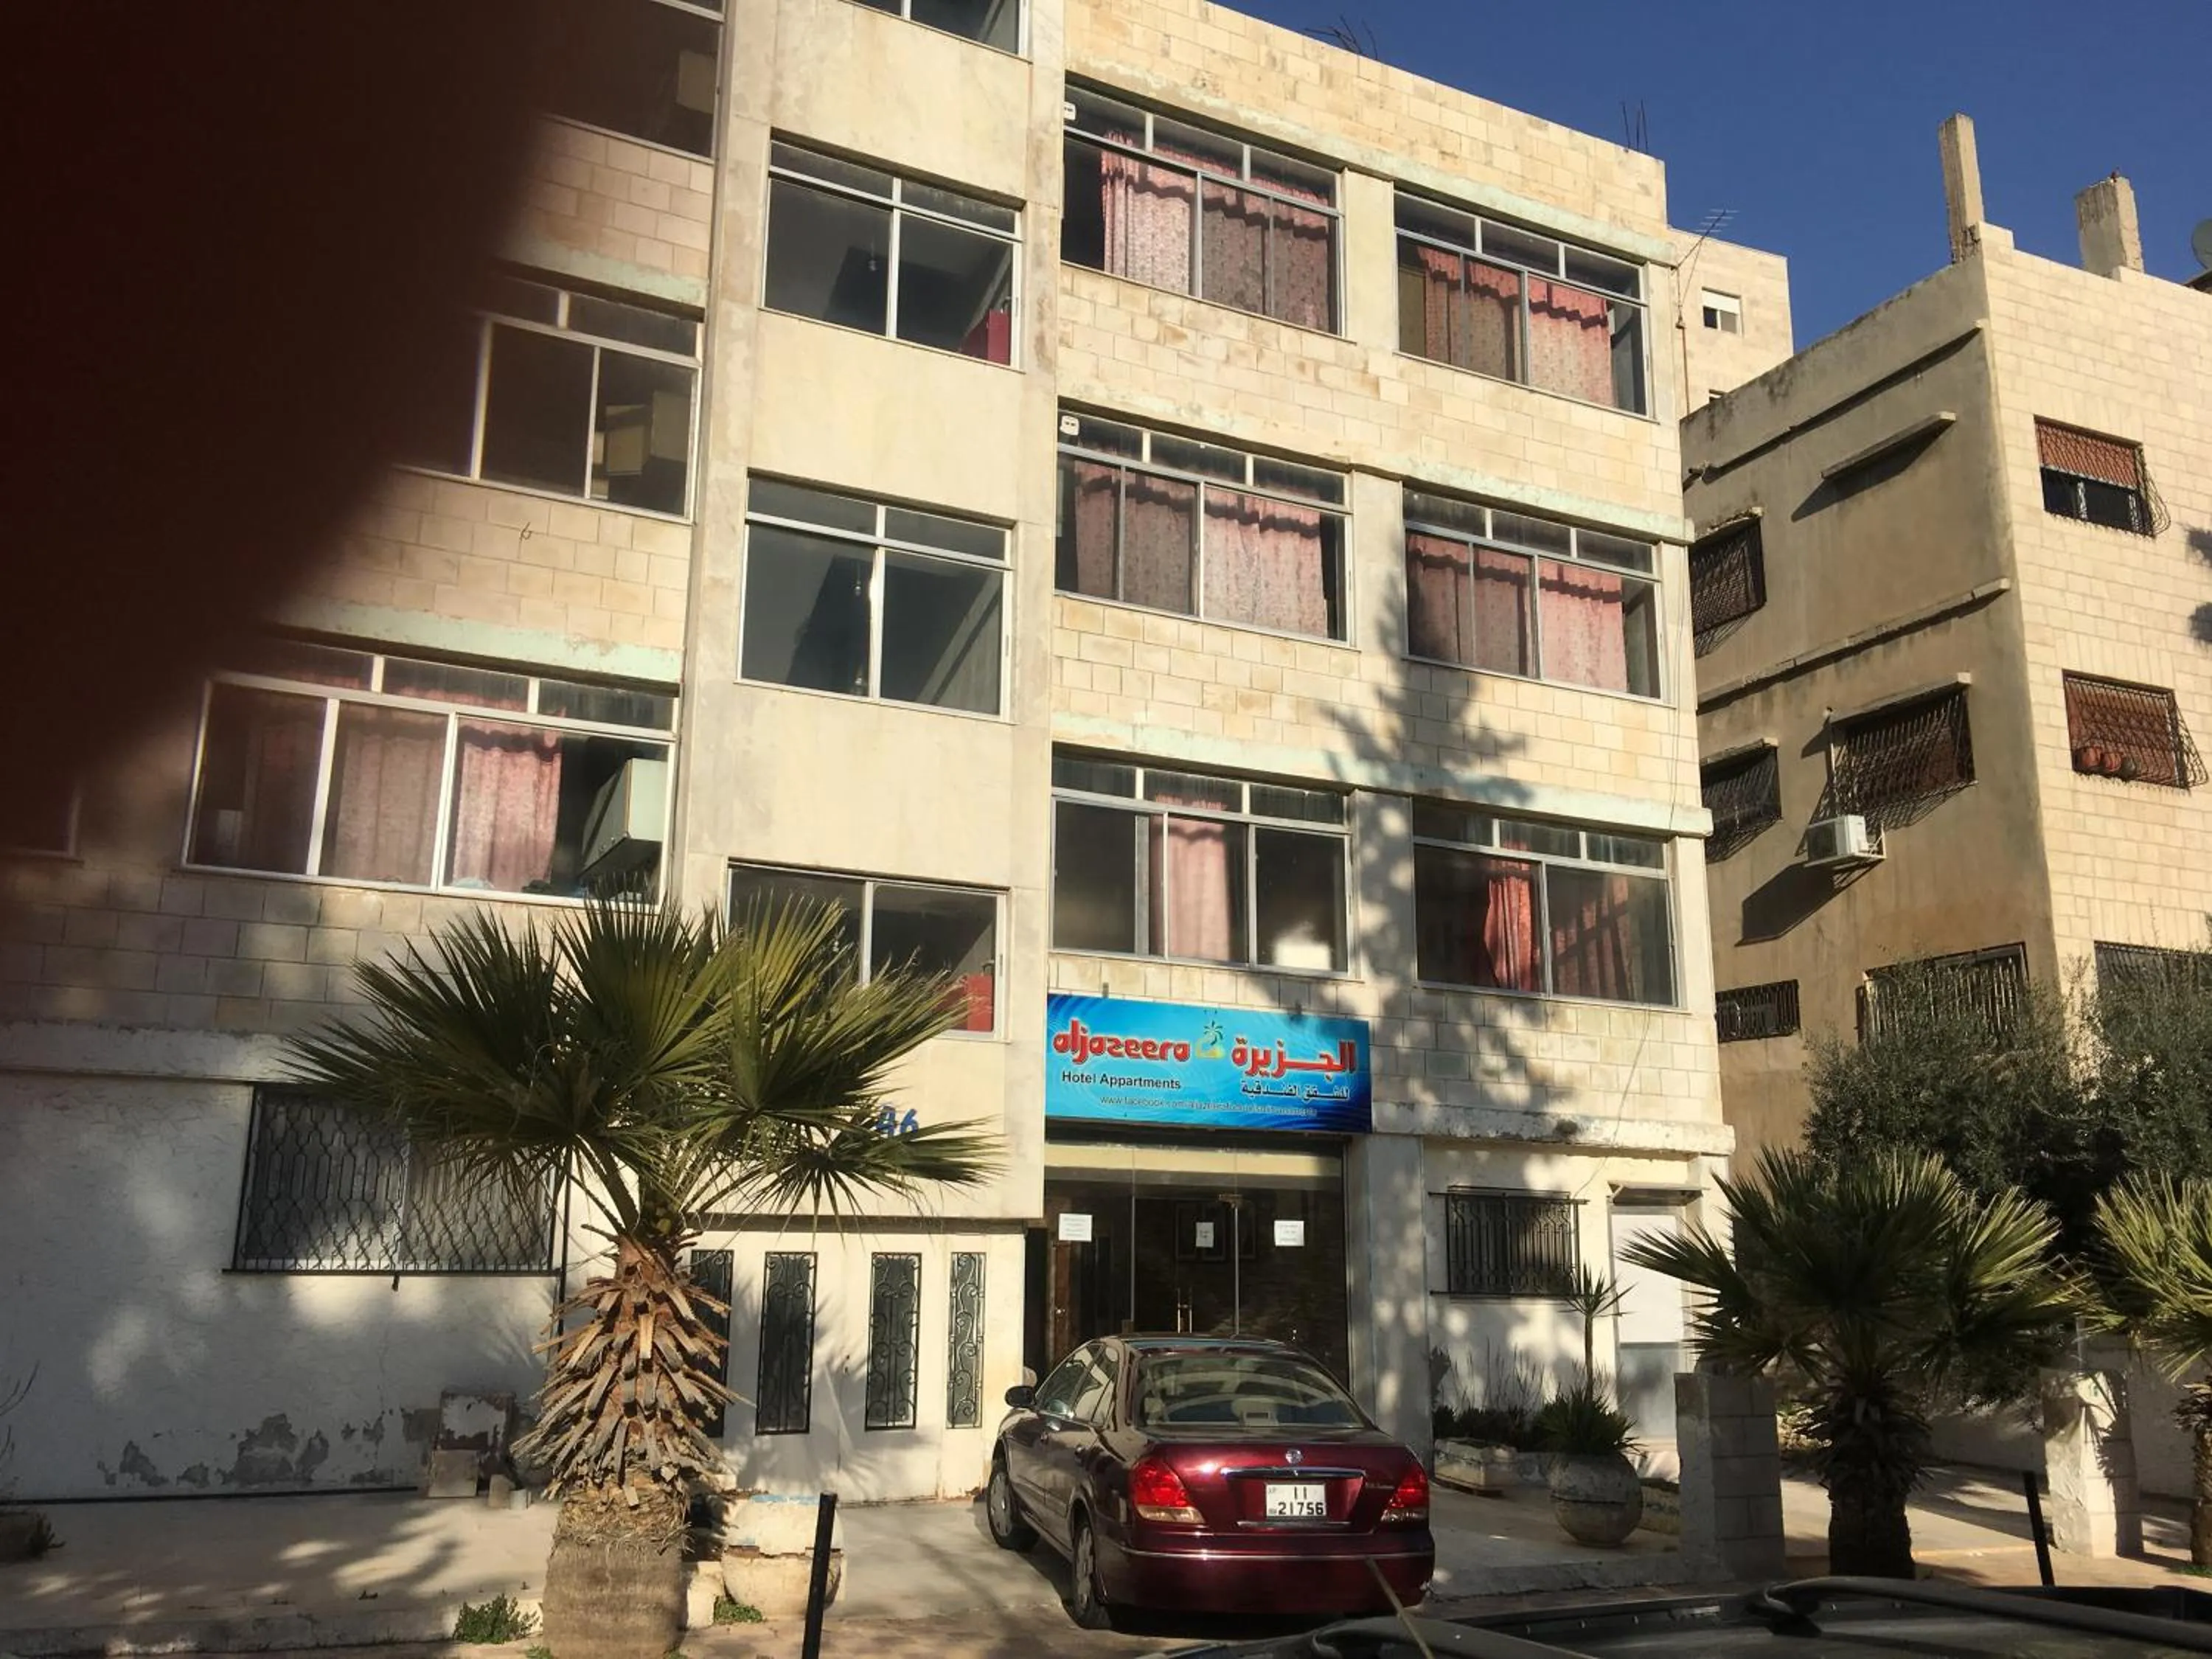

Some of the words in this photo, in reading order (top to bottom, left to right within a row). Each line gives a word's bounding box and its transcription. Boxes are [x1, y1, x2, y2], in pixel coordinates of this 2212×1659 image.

[1053, 1019, 1191, 1065] aljazeera
[1231, 1037, 1357, 1082] الجزيرة
[1062, 1071, 1096, 1084] Hotel
[1099, 1074, 1181, 1089] Appartments
[1242, 1080, 1297, 1098] الفندقية
[1278, 1501, 1324, 1515] 21756
